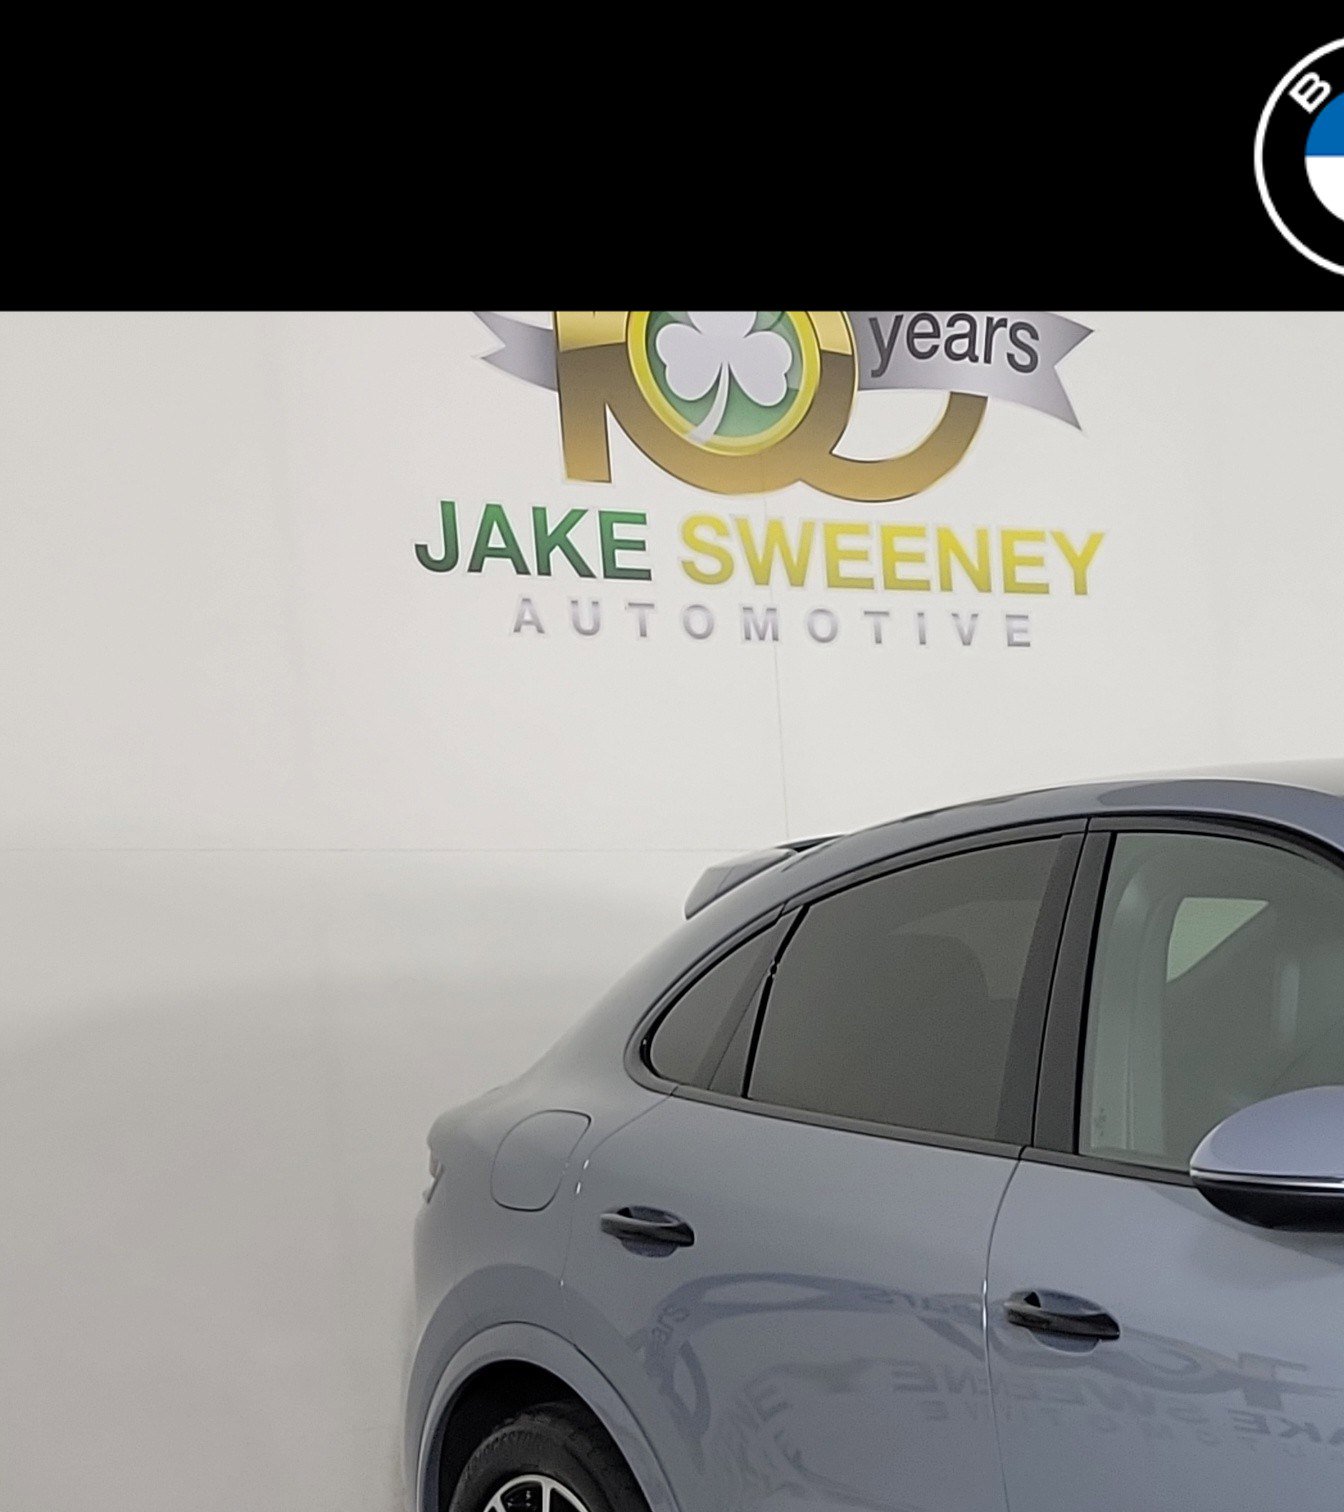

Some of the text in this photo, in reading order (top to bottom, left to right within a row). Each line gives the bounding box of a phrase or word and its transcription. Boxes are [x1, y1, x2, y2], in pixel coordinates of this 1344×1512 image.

[869, 312, 1039, 378] years
[414, 500, 1106, 596] JAKE SWEENEY
[512, 598, 1032, 647] AUTOMOTIVE
